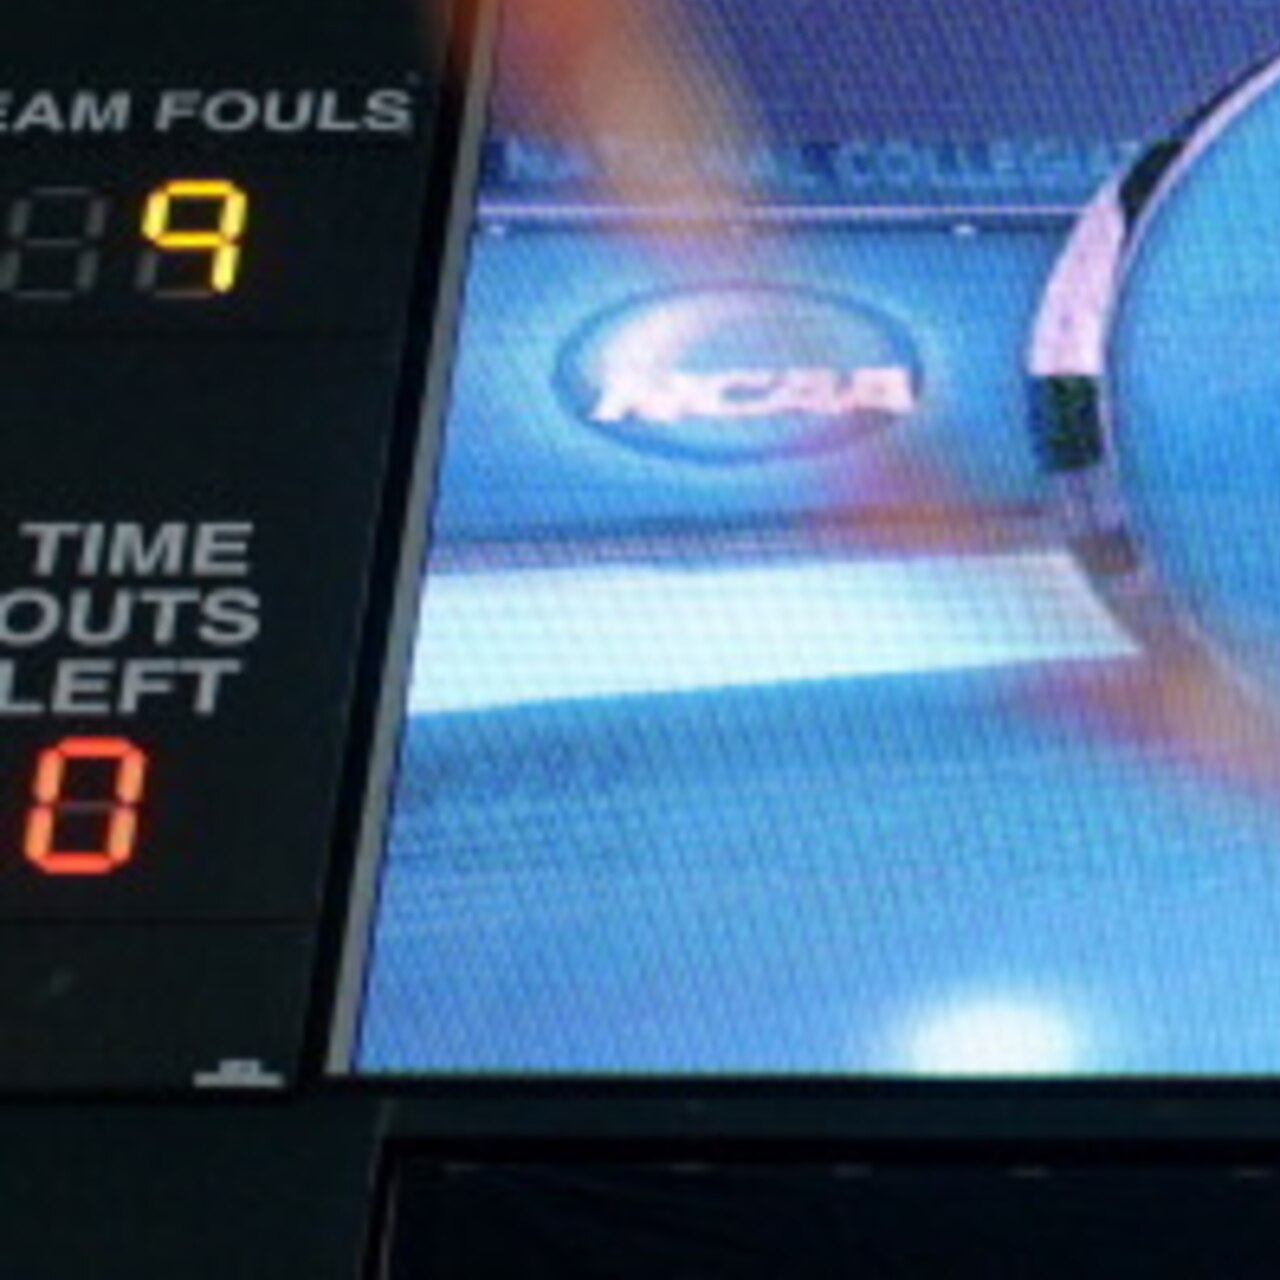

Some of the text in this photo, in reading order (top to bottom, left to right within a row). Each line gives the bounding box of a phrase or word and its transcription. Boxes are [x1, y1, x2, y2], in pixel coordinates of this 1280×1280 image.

[155, 88, 414, 132] FOULS
[141, 178, 247, 294] 9
[588, 365, 915, 422] NCAA
[18, 521, 255, 577] TIME
[0, 587, 262, 647] OUTS
[0, 658, 242, 715] LEFT
[24, 735, 147, 875] 0
